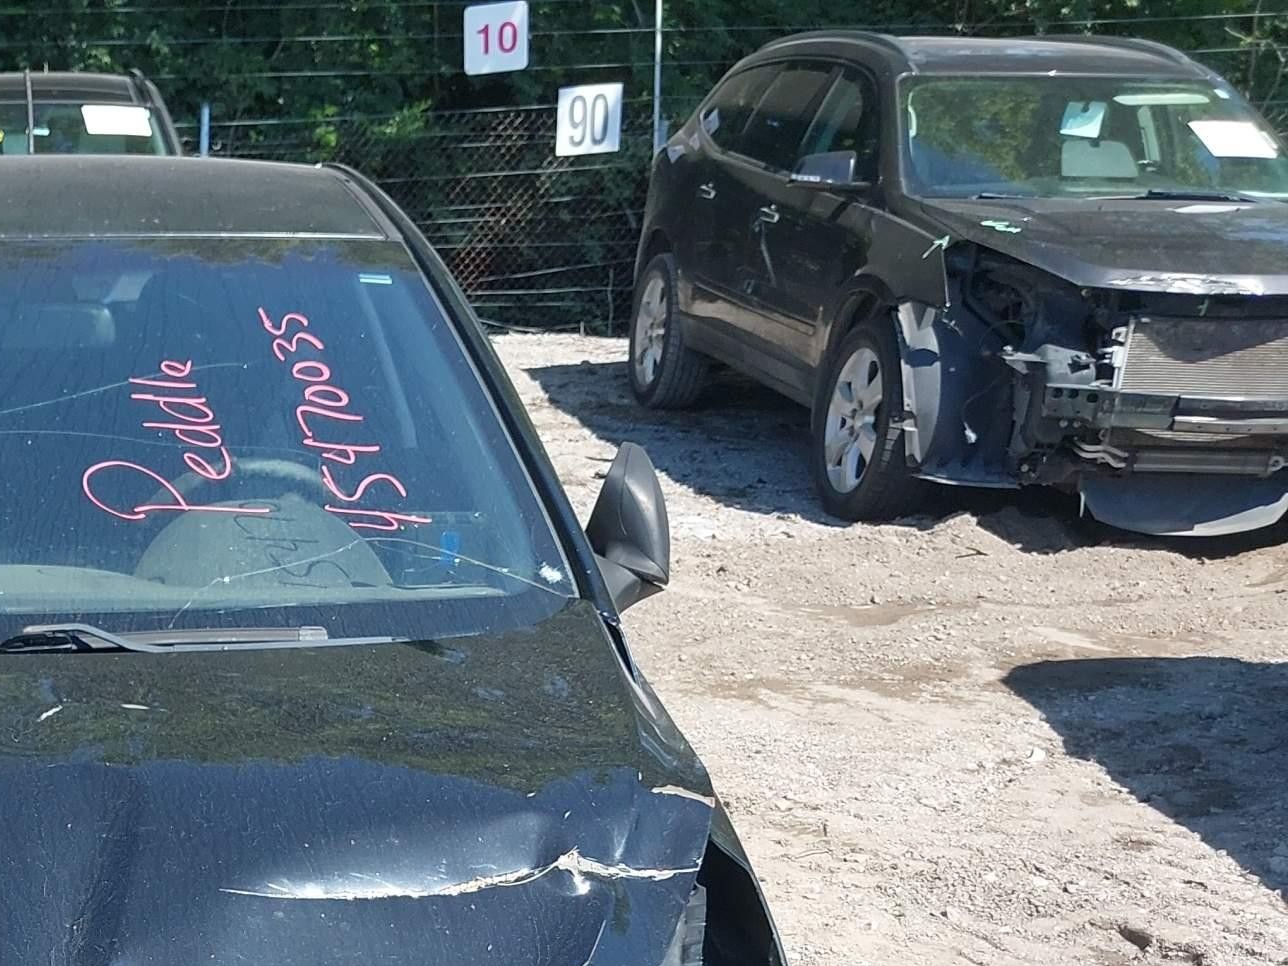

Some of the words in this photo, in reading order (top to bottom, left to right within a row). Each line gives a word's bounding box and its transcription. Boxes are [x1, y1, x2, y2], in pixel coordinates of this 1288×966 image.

[476, 21, 518, 55] 10
[568, 93, 609, 148] 90
[258, 306, 433, 531] 45470035
